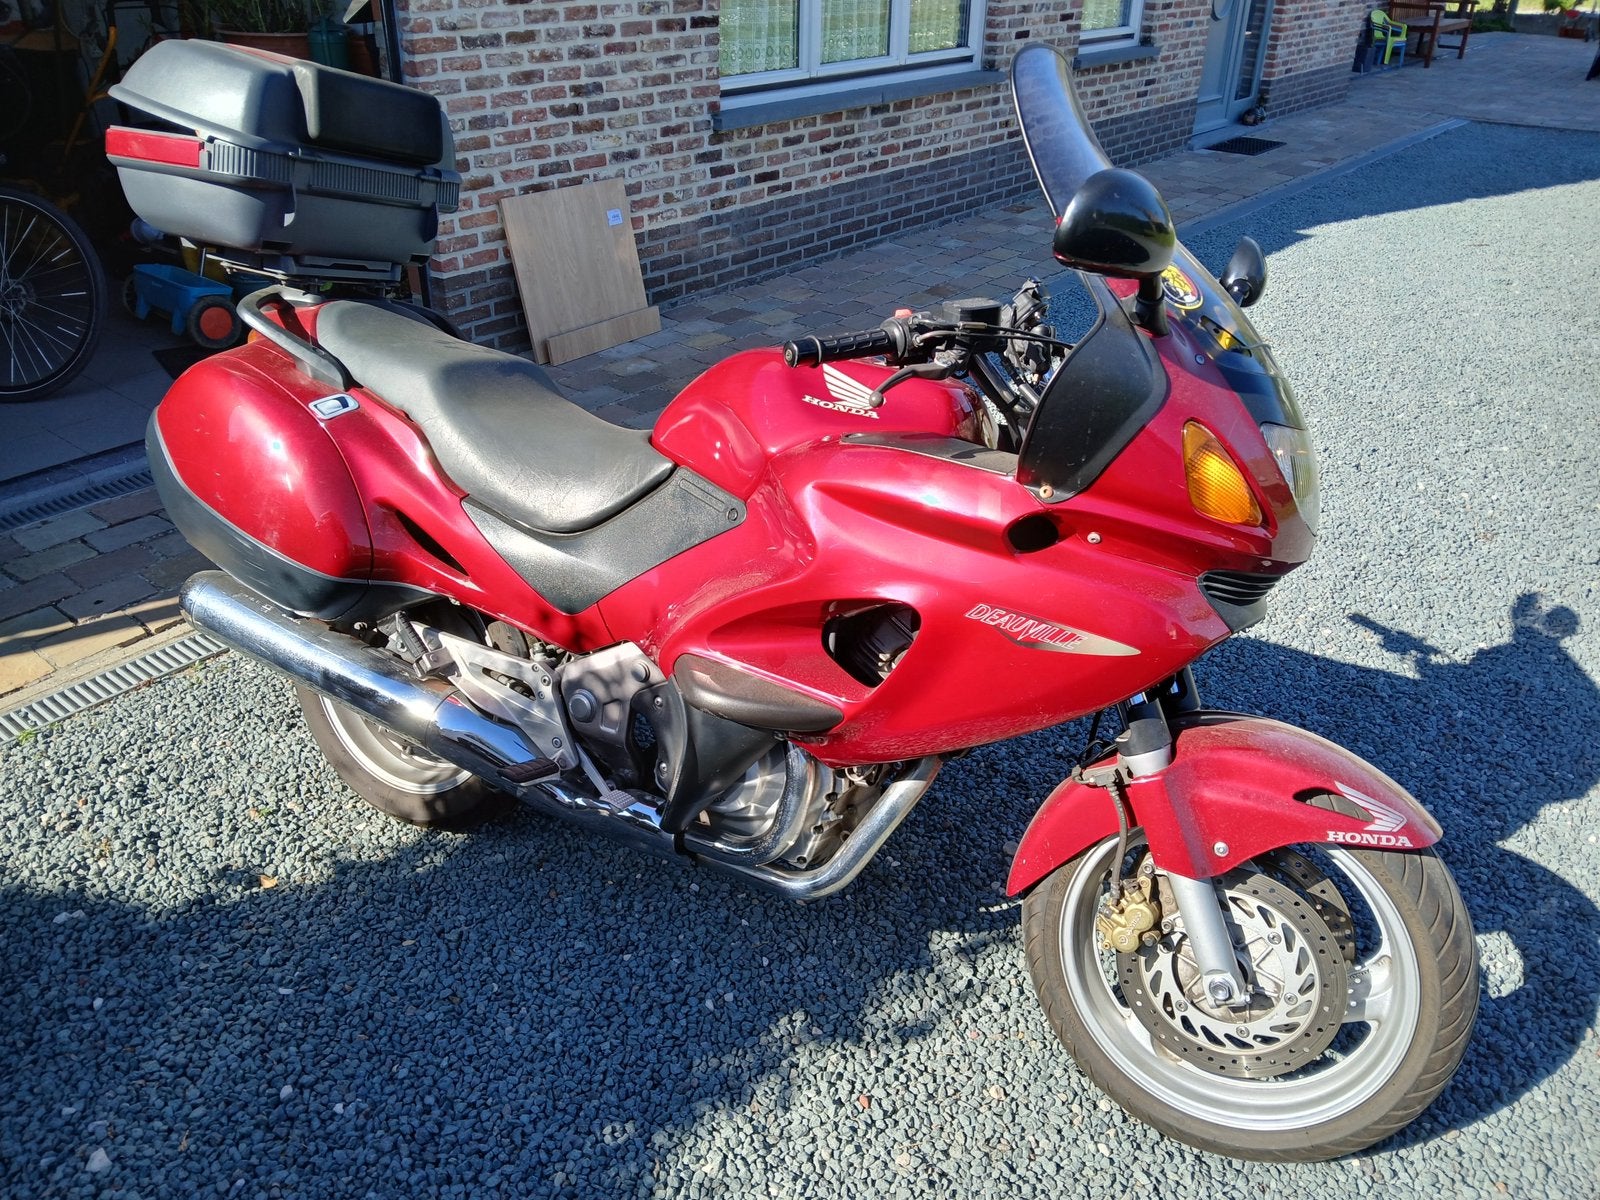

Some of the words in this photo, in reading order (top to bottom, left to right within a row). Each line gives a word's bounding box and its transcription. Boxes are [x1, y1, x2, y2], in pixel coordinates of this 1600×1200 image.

[802, 394, 880, 419] HONDA
[964, 603, 1088, 650] DEAUVILLE
[1326, 831, 1413, 847] HONDA
